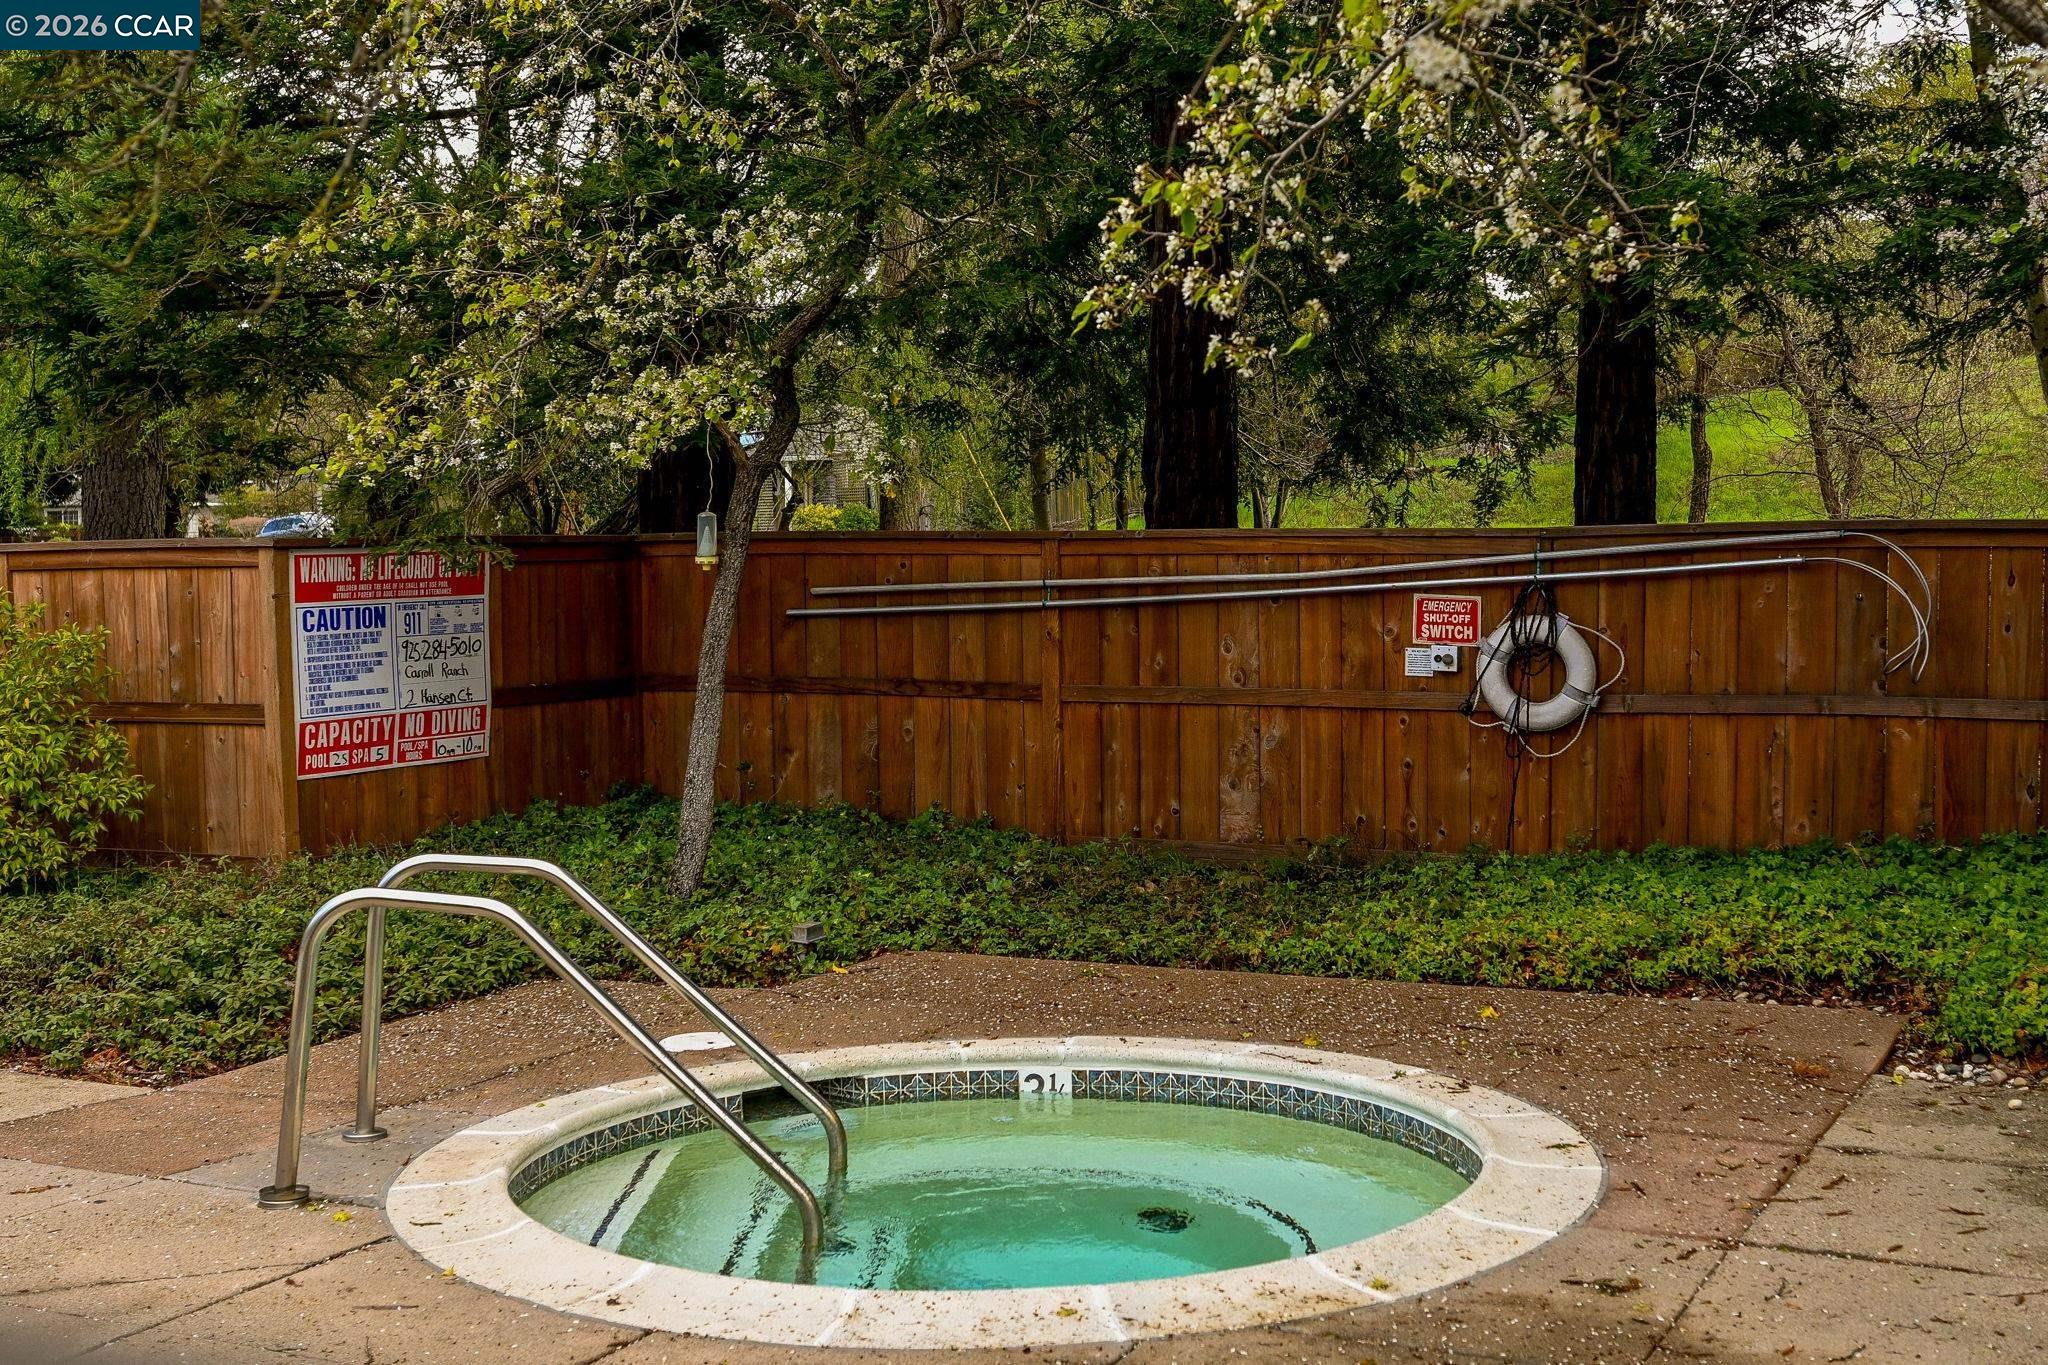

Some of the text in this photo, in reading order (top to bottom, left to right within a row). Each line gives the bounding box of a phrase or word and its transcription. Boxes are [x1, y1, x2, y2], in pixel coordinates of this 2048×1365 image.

[299, 556, 356, 584] WARNING:
[419, 581, 428, 589] NOT
[1422, 600, 1472, 613] EMERGENCY
[302, 606, 387, 632] CAUTION
[403, 612, 422, 634] 911
[1423, 613, 1471, 623] SHUT-OFF
[1421, 624, 1473, 640] SWITCH
[441, 661, 469, 679] Ranch
[405, 689, 417, 708] 2
[421, 687, 457, 704] Hansen
[404, 707, 481, 738] NO DIVING
[304, 716, 393, 749] CAPACITY
[400, 739, 429, 751] POOL/SPA
[305, 747, 384, 770] POOL 25 SPA 5
[405, 751, 423, 761] HOURS
